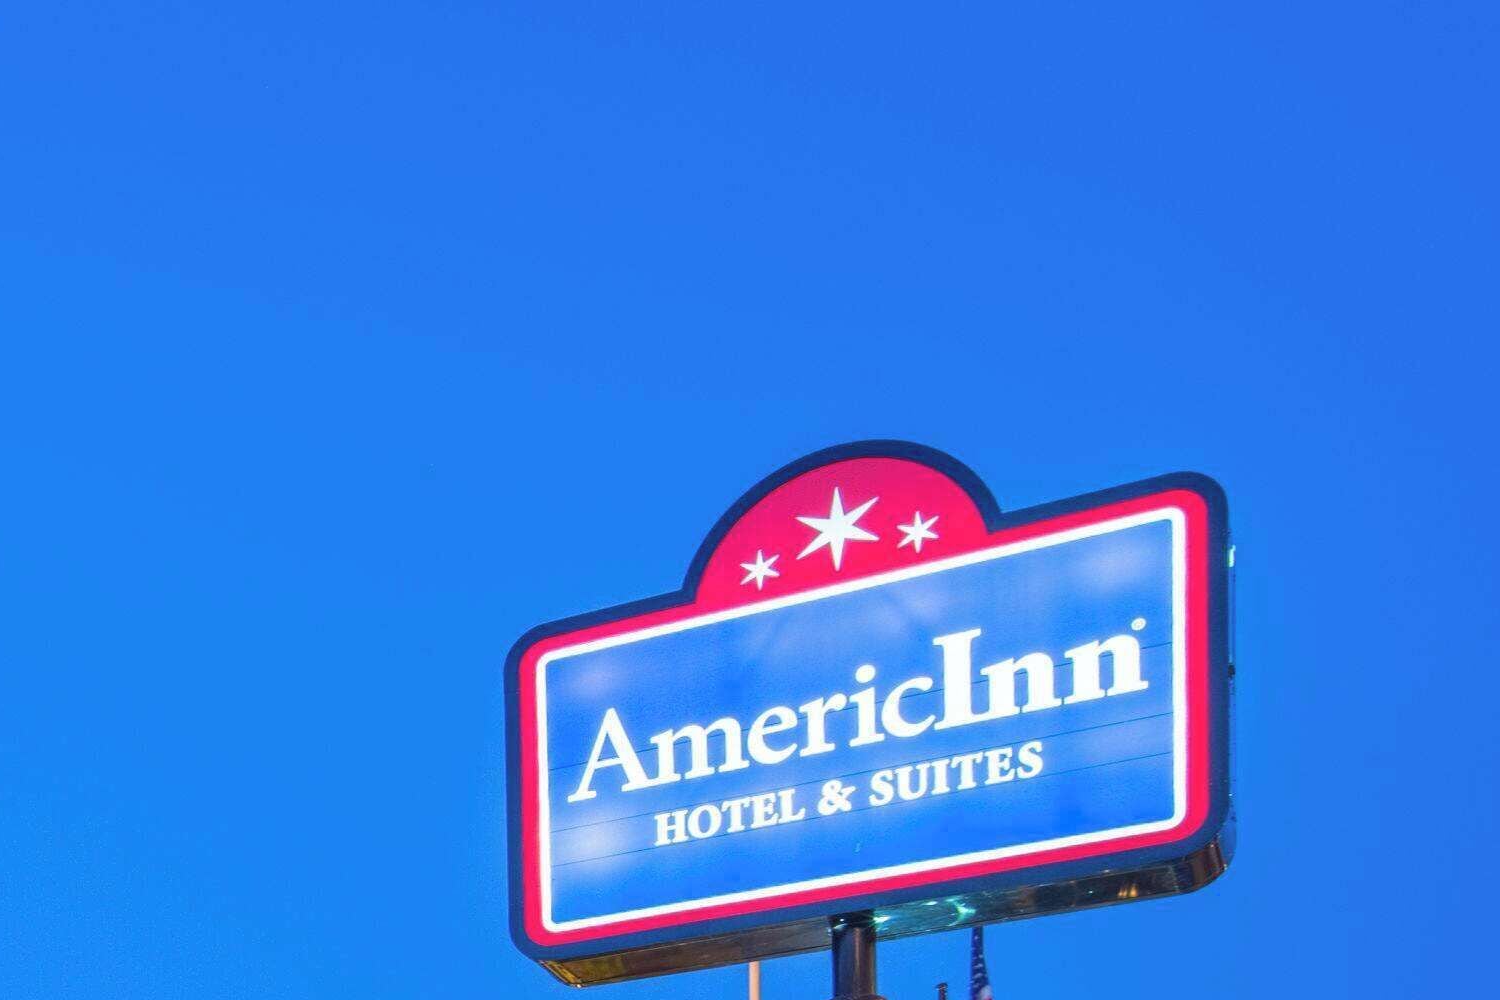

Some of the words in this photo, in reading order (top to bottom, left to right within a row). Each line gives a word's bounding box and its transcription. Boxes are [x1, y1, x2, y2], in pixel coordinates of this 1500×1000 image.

[567, 628, 1149, 803] AmericInn
[654, 787, 806, 846] HOTEL
[818, 779, 857, 816] &
[869, 741, 1044, 808] SUITES
